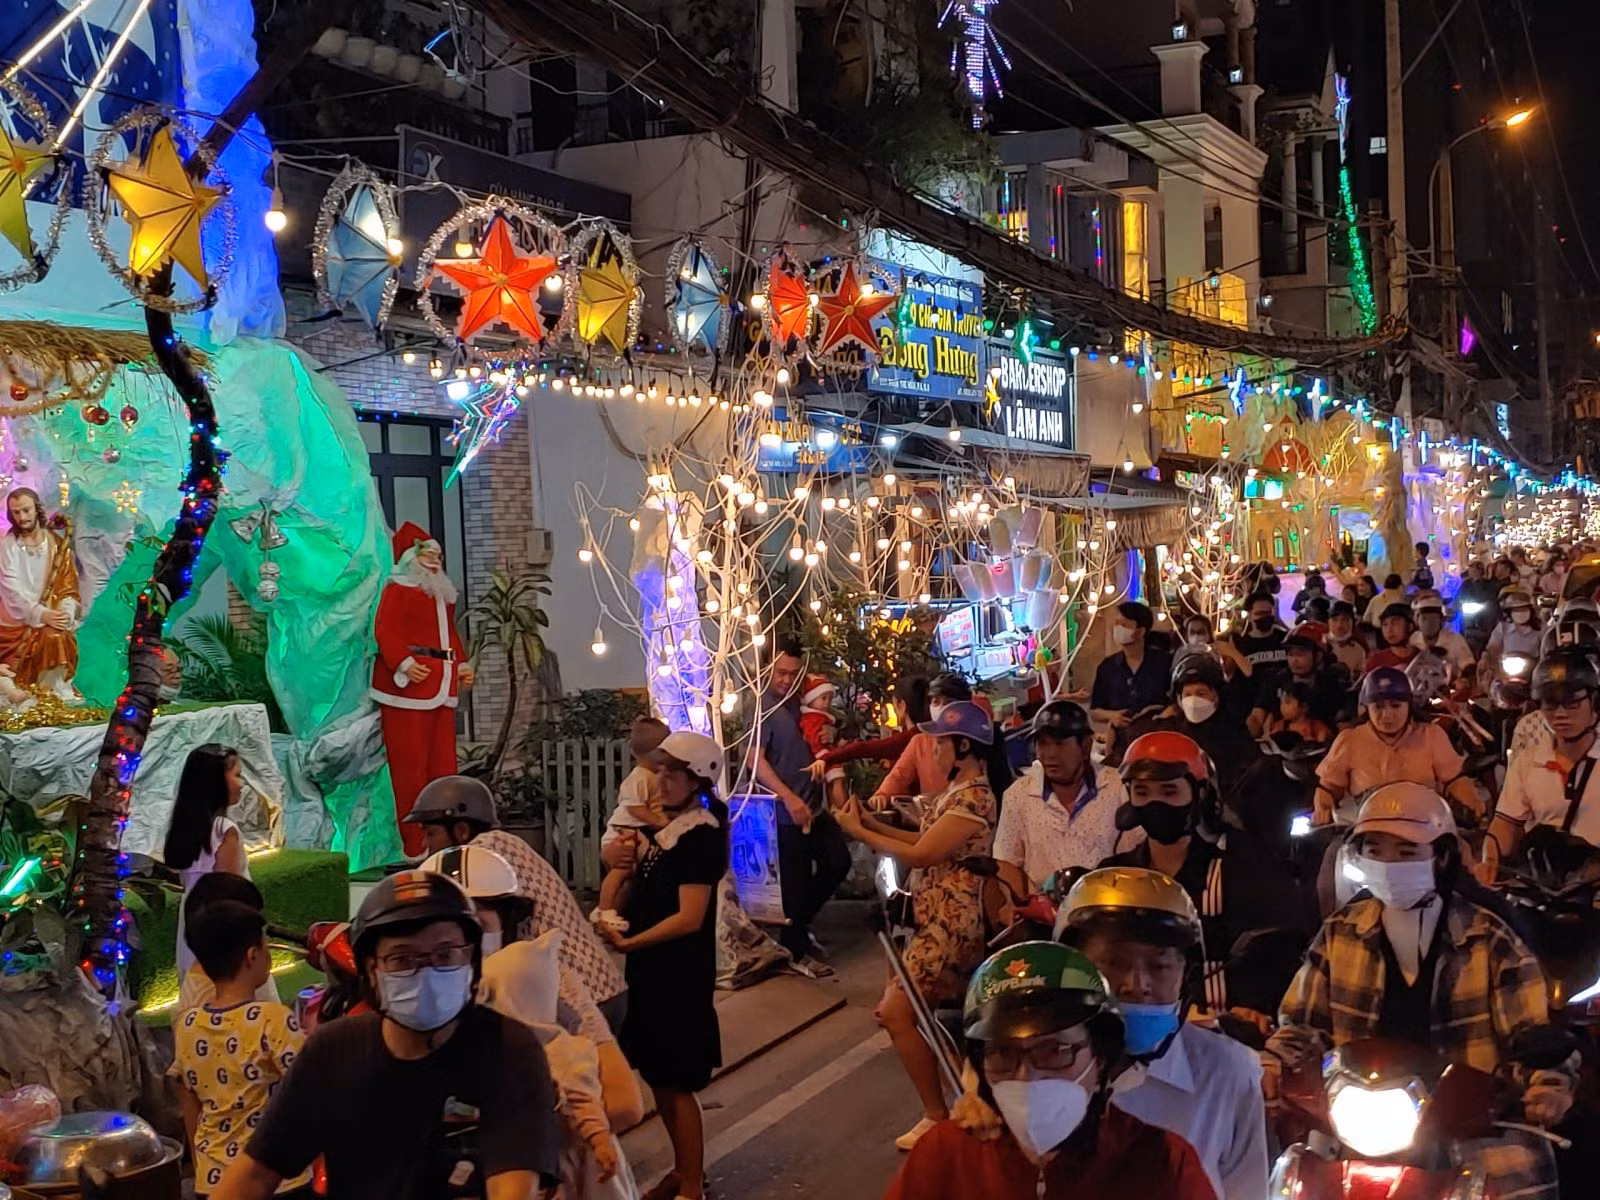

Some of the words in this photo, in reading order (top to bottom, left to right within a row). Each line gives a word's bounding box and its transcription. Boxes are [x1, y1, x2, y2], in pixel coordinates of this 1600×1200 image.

[935, 336, 979, 386] Hưng
[1006, 399, 1038, 441] LÂM
[1038, 410, 1063, 443] ANH
[211, 1013, 222, 1025] G
[247, 1006, 260, 1020] G
[196, 1040, 208, 1056] G
[227, 1037, 237, 1053] G
[218, 1068, 227, 1084] G
[244, 1064, 258, 1080] G
[227, 1142, 238, 1157] G
[208, 1168, 220, 1184] G
